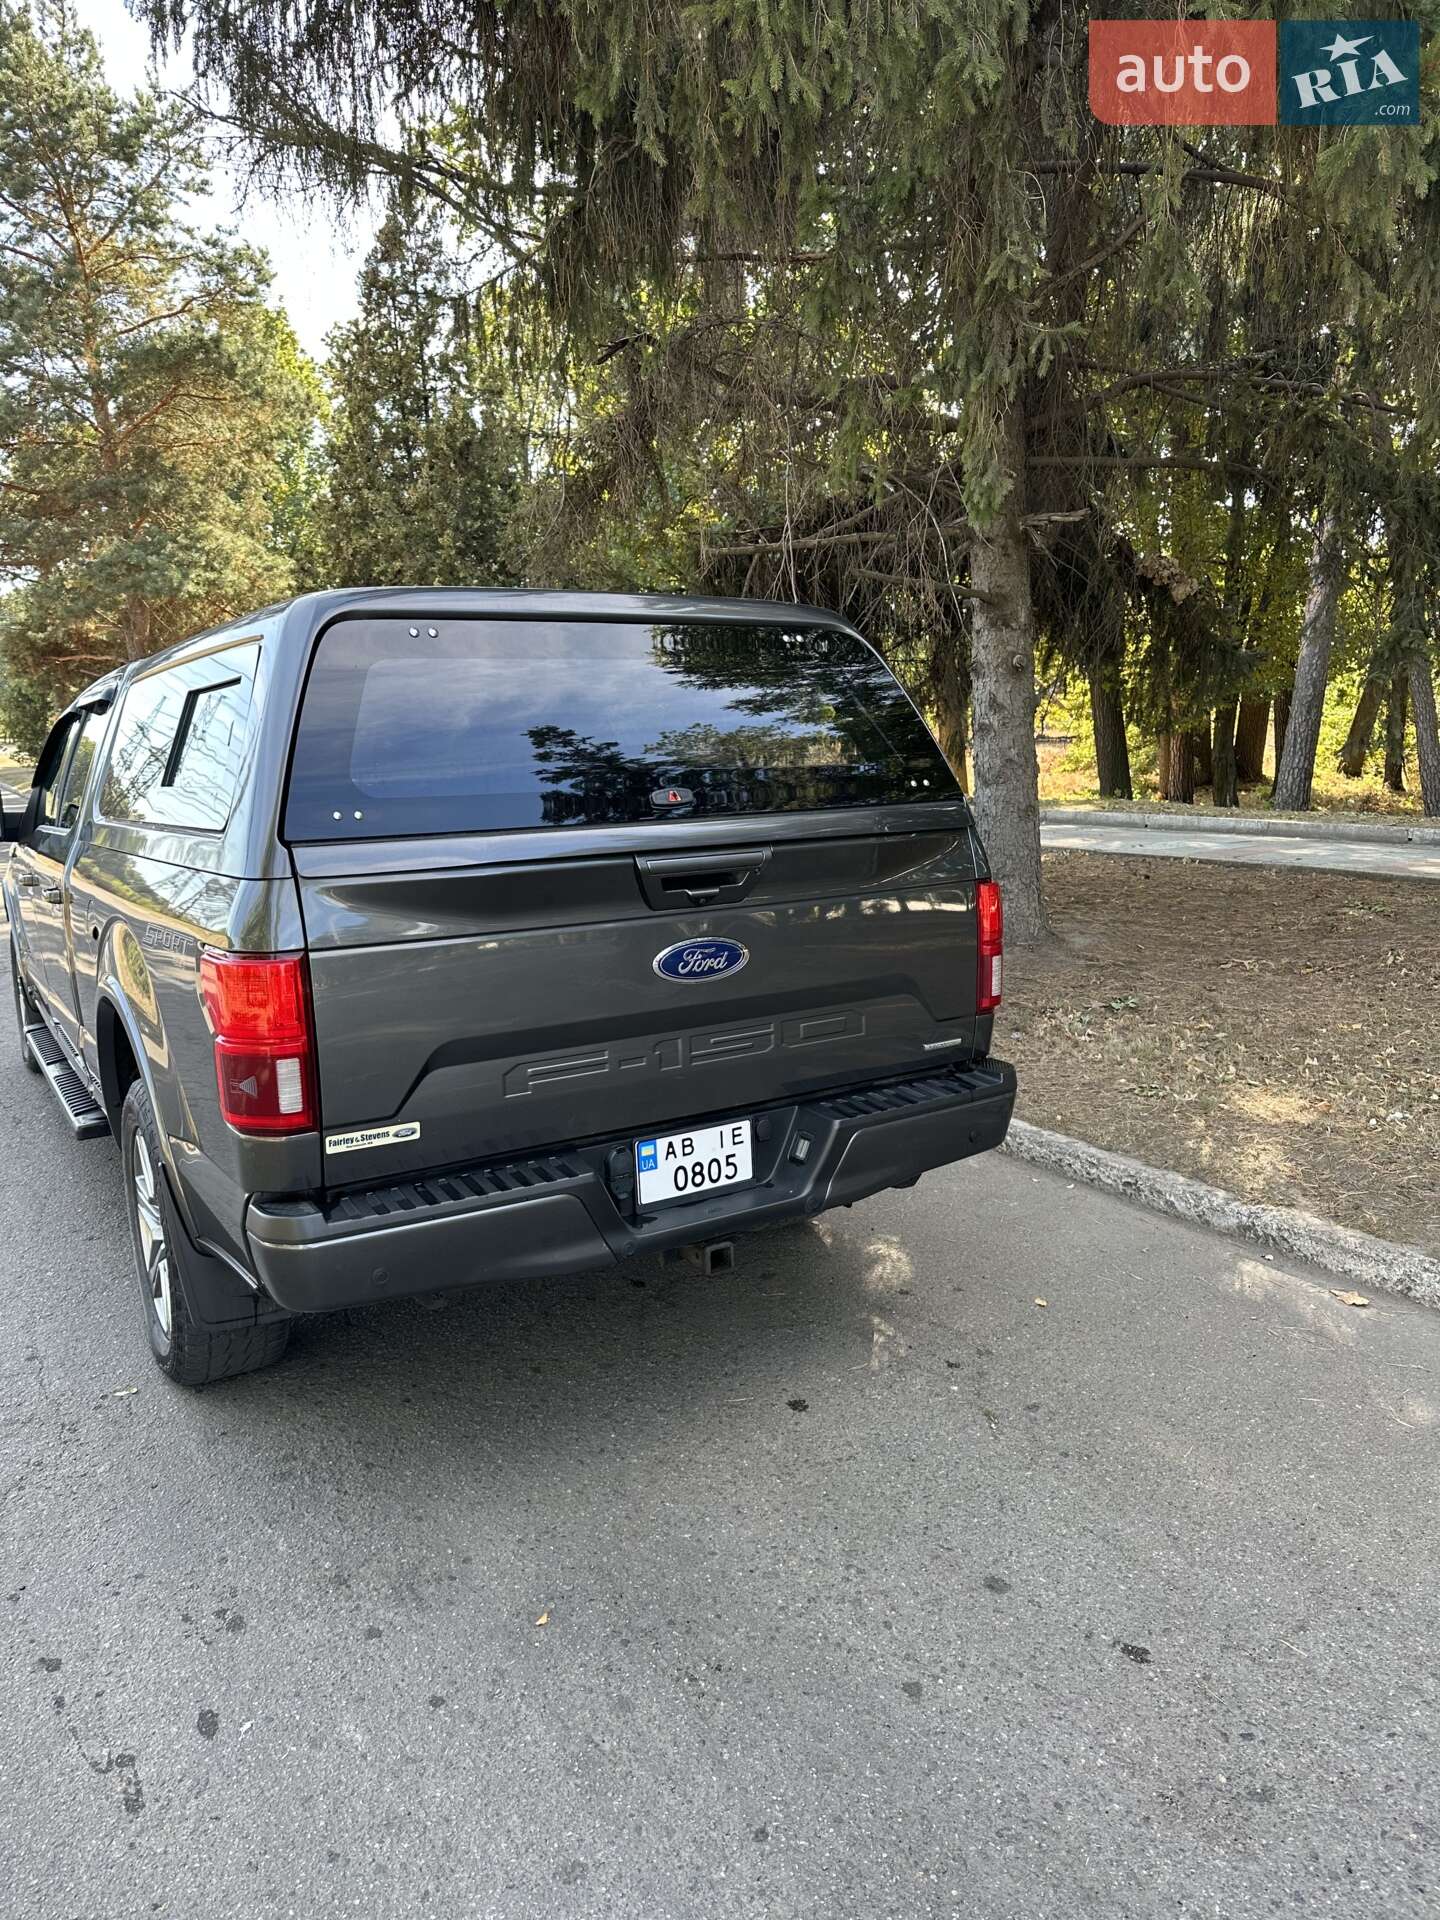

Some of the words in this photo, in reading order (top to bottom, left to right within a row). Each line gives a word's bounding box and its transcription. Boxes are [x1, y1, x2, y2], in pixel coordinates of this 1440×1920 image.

[143, 922, 195, 955] SPORT
[678, 947, 729, 975] Ford
[502, 1009, 867, 1099] F-150
[328, 1136, 354, 1148] Fairley
[360, 1131, 390, 1143] Stevens
[665, 1137, 695, 1160] AB
[719, 1126, 744, 1149] IE
[641, 1160, 656, 1170] UA
[673, 1153, 738, 1191] 0805
